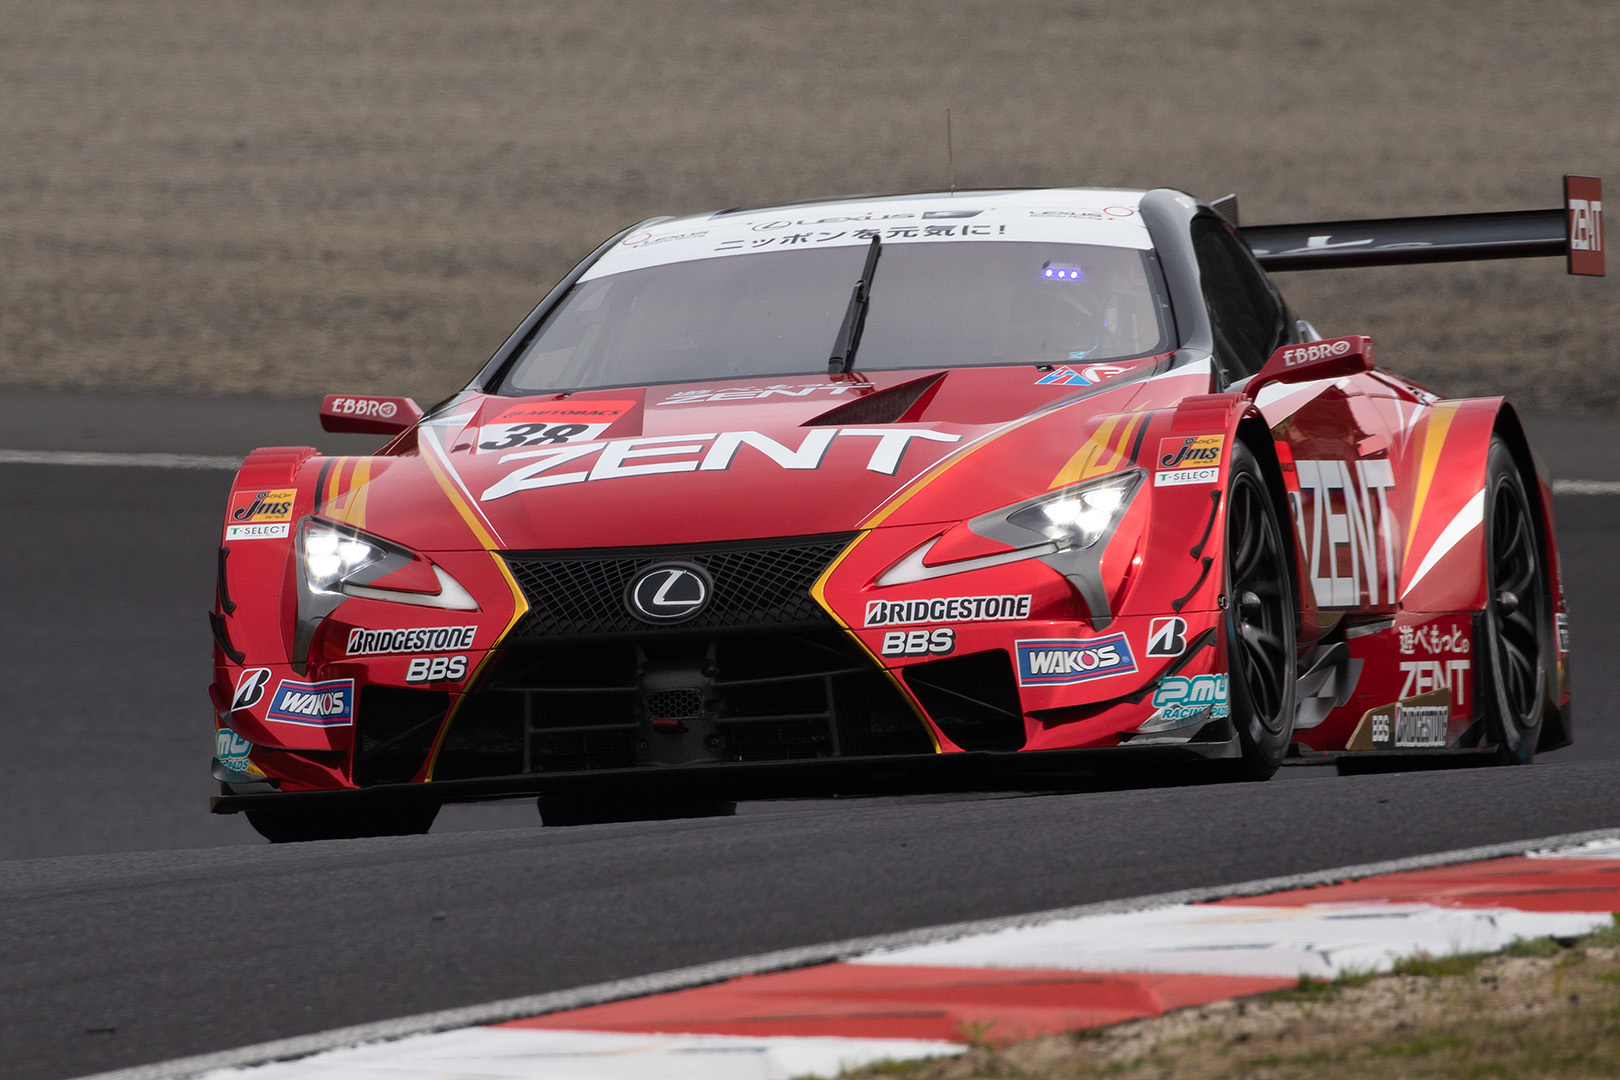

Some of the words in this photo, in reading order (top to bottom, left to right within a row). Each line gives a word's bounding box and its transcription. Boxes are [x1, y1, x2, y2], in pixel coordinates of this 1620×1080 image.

[796, 212, 916, 225] LEXUS
[1568, 199, 1602, 252] ZENT
[1283, 340, 1351, 367] EBBRO
[332, 397, 397, 418] EBBRO
[479, 422, 590, 450] 38
[480, 428, 964, 502] ZENT
[1159, 470, 1216, 481] T-SELECT
[231, 525, 286, 535] T-SELECT
[1294, 458, 1396, 608] ZENT
[866, 596, 1030, 626] BRIDGESTONE
[347, 627, 476, 654] BRIDGESTONE
[881, 628, 956, 657] BBS
[406, 656, 468, 684] BBS
[1398, 659, 1470, 705] ZENT
[227, 759, 250, 771] PADS
